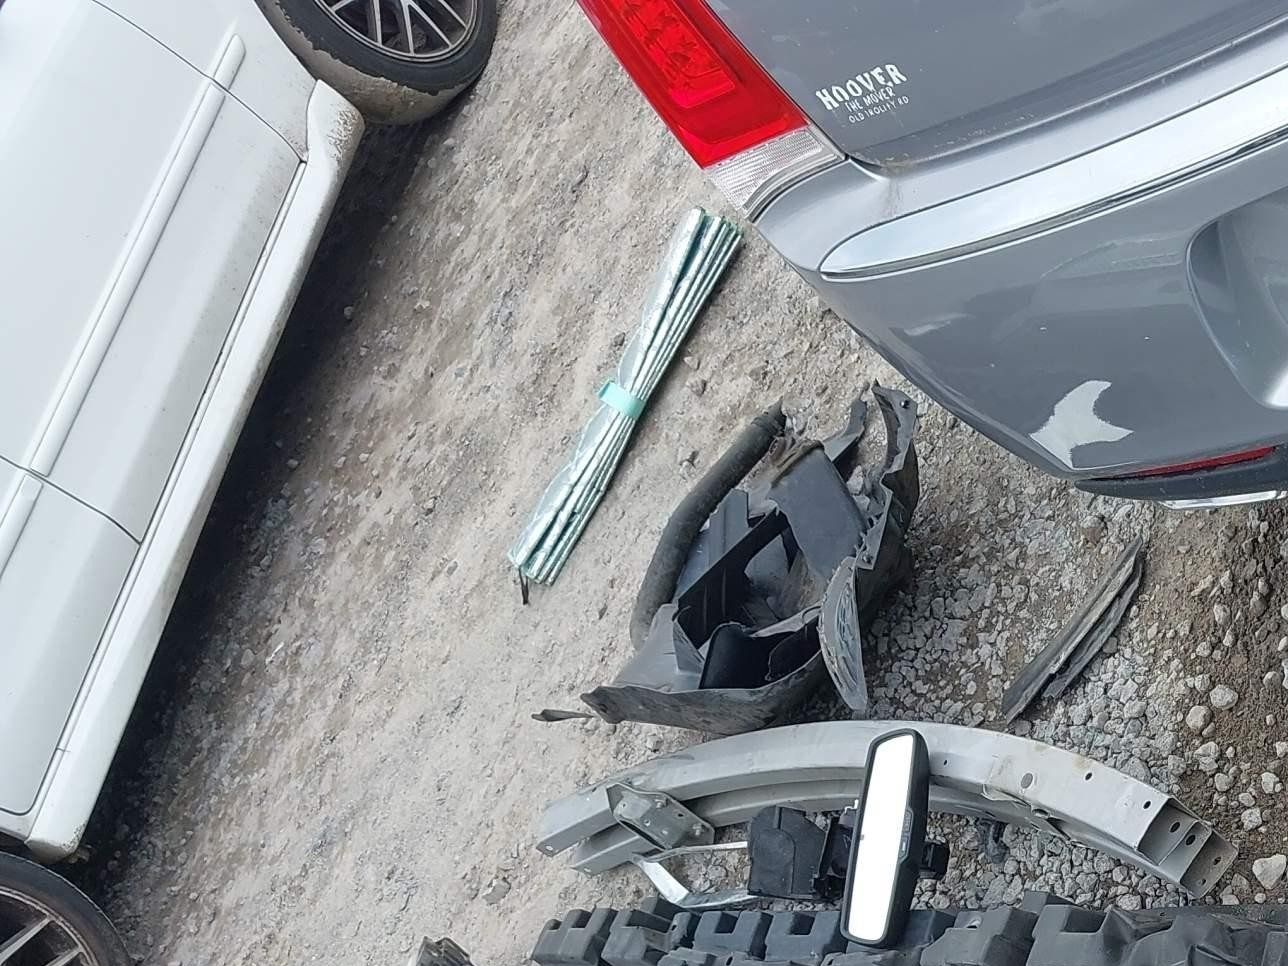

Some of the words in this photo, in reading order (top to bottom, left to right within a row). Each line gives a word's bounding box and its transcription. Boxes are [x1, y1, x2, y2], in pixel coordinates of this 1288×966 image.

[815, 64, 907, 110] HOOVER
[845, 99, 863, 112] THE
[863, 87, 896, 106] MOVER
[849, 112, 865, 123] OLD
